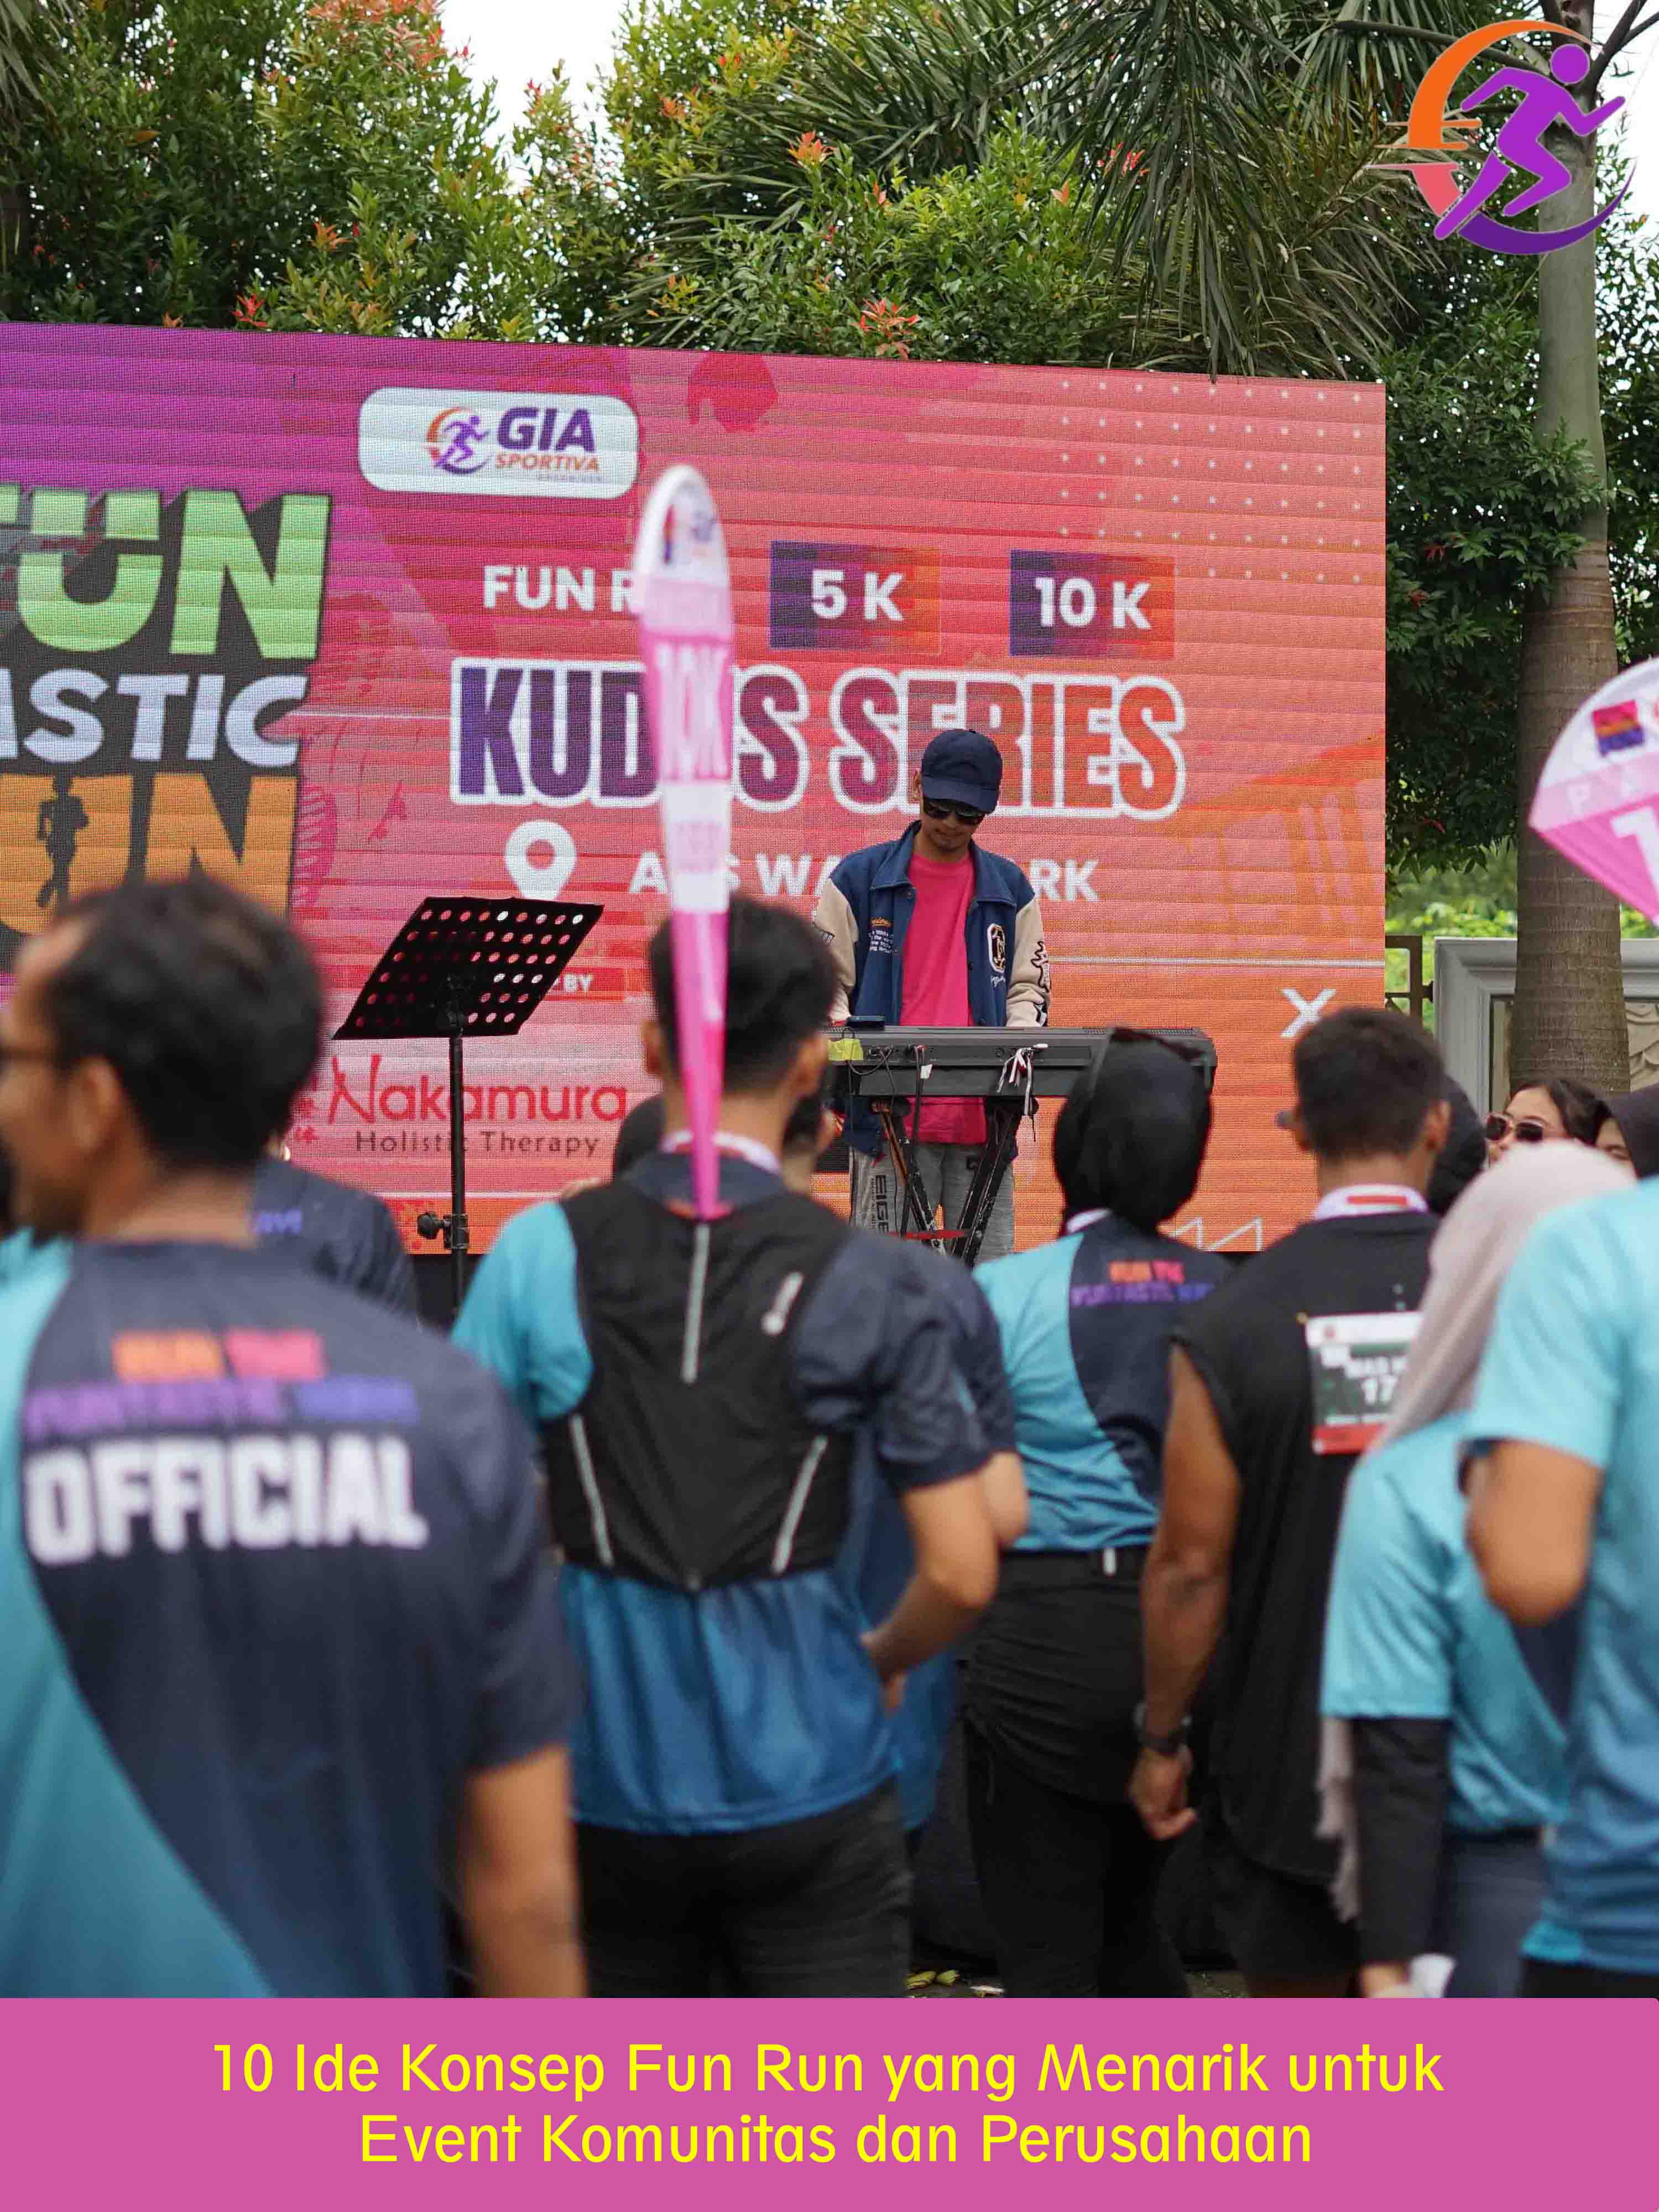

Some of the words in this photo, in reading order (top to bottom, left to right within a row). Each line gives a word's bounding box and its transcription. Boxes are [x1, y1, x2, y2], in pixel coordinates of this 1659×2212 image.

[498, 407, 595, 452] GIA
[495, 453, 601, 472] SPORTIVA
[483, 565, 594, 612] FUN
[811, 570, 847, 619] 5
[864, 572, 904, 621] K
[1035, 577, 1097, 628] 10
[1112, 581, 1152, 630] K
[450, 658, 809, 813] KUDS
[328, 1053, 626, 1123] Nakamura
[481, 1131, 597, 1156] Therapy
[25, 1433, 430, 1564] OFFICIAL
